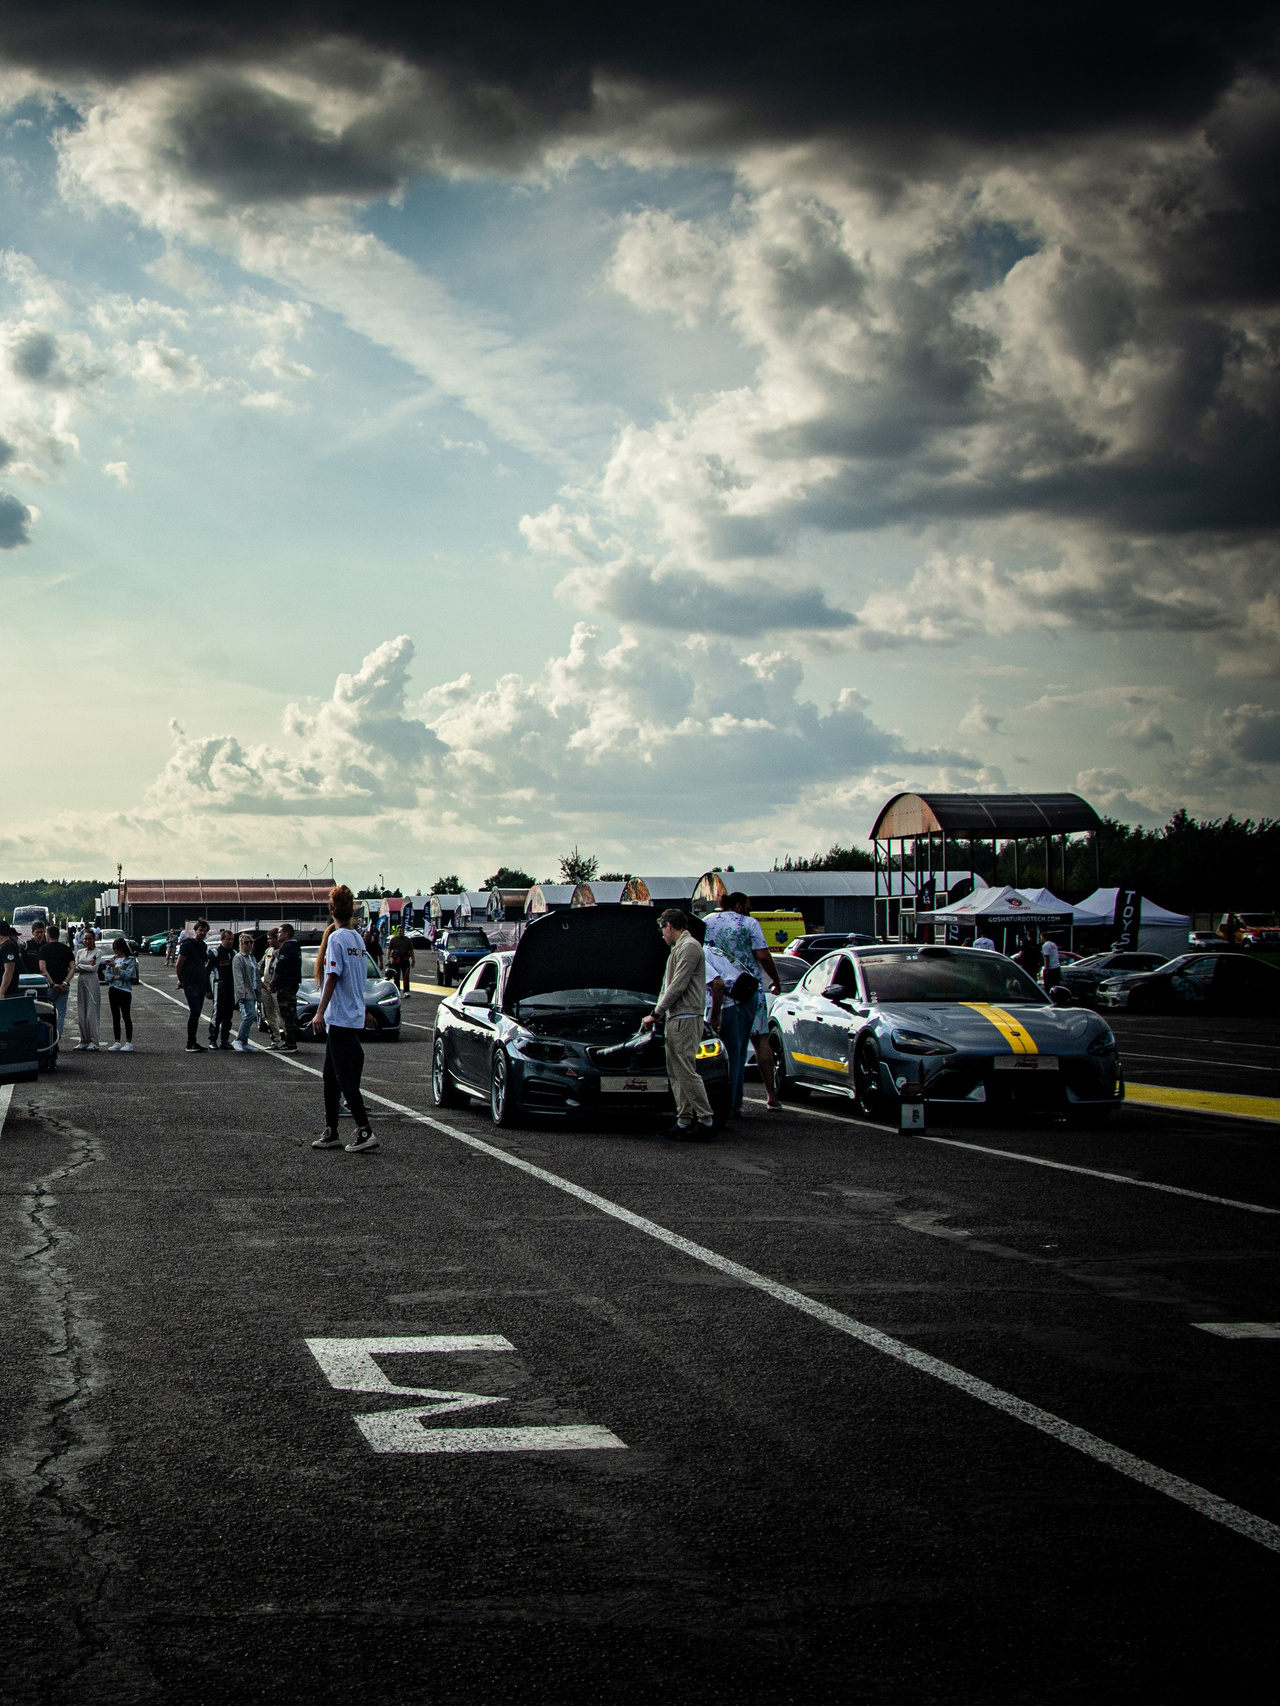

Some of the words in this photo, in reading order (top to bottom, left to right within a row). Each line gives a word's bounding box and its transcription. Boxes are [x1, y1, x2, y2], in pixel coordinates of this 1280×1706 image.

[949, 924, 960, 941] TO
[988, 915, 1061, 923] GOSHATURBOTECH.COM
[1121, 890, 1136, 945] TOYS
[304, 1334, 629, 1454] 3
